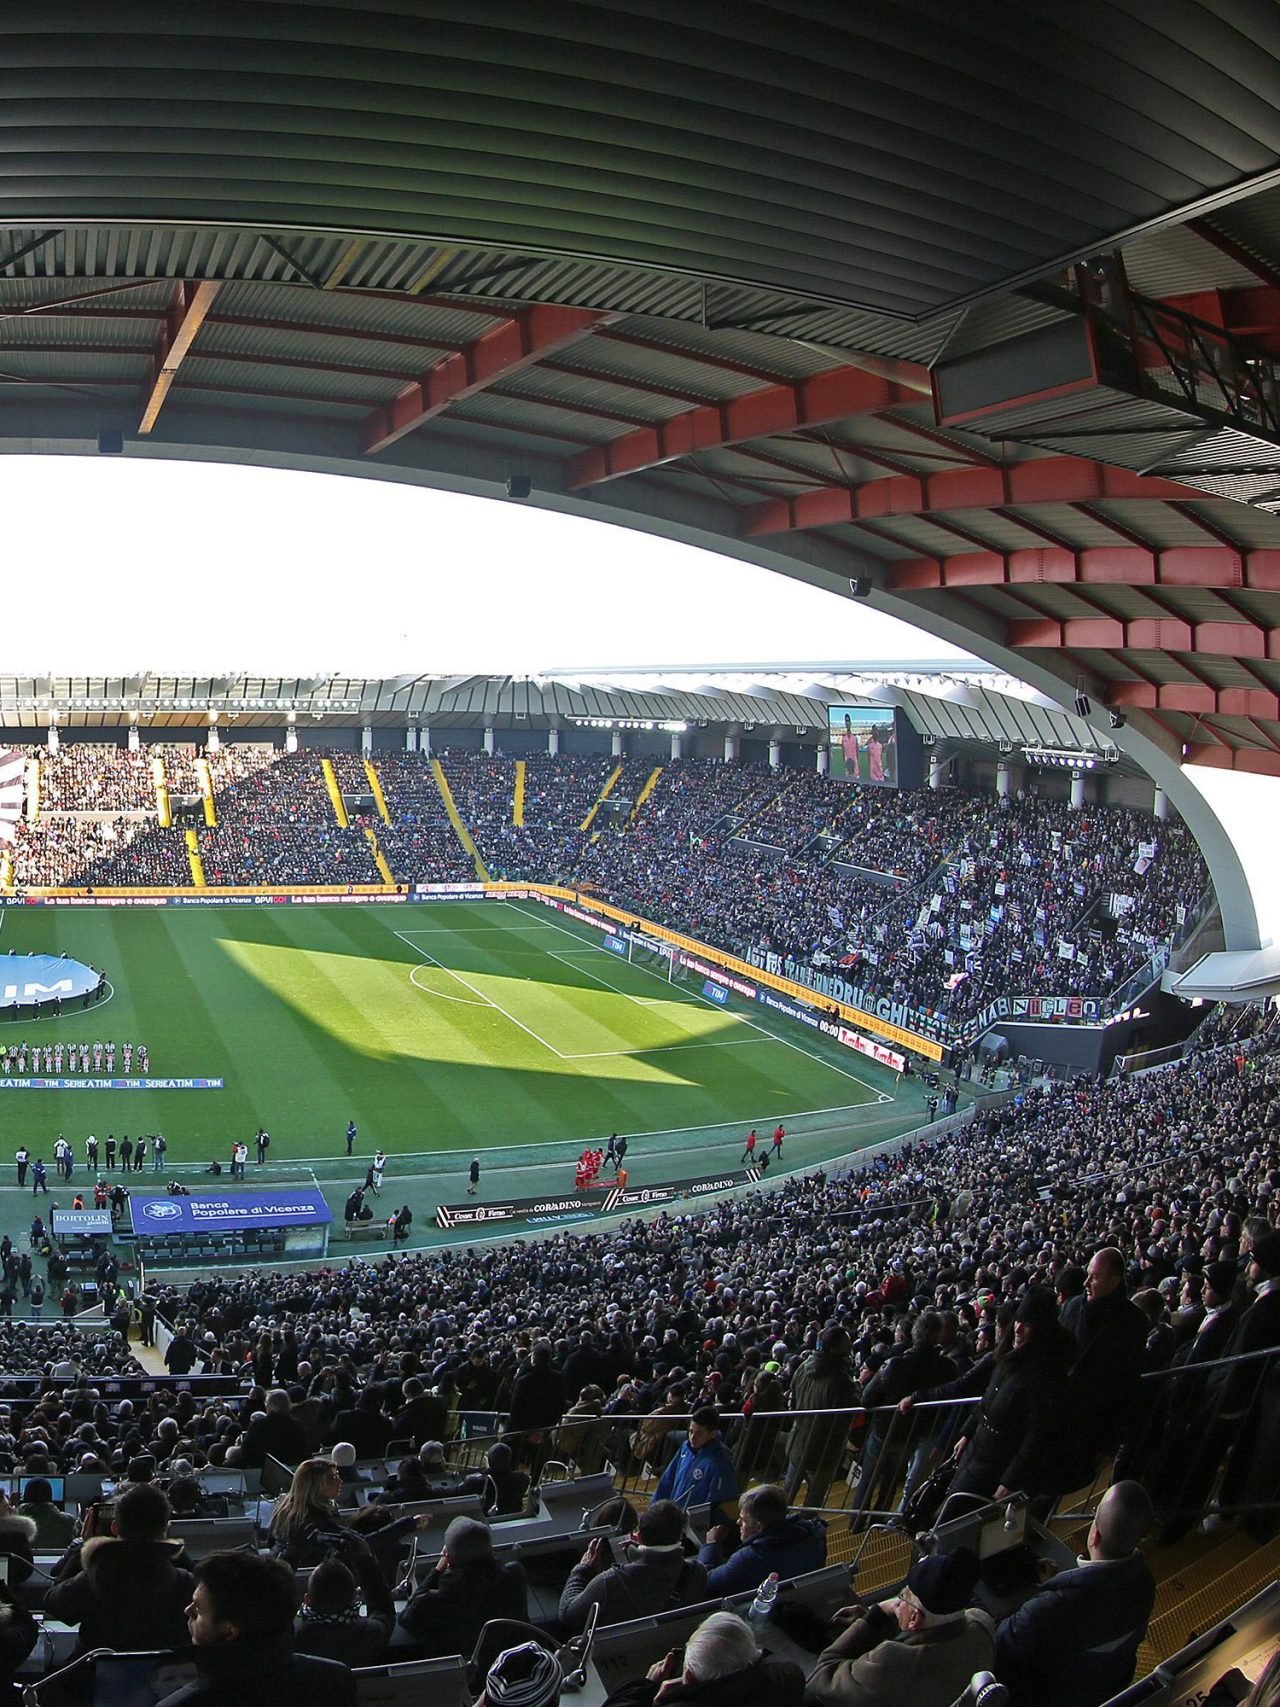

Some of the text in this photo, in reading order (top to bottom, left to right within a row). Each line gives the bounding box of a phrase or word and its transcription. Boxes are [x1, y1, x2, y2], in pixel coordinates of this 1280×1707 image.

[44, 897, 54, 905] La
[56, 897, 69, 905] tua
[70, 897, 95, 905] banca
[96, 898, 126, 906] sempre
[133, 898, 167, 906] ovunque
[200, 897, 223, 905] Popolare
[291, 895, 301, 903] La
[317, 895, 339, 904] banca
[340, 896, 369, 905] sempre
[376, 895, 407, 904] ovunque
[434, 893, 457, 901] Popolare
[464, 892, 484, 900] Vicenza
[611, 939, 623, 951] TIM
[679, 955, 686, 966] La
[686, 958, 695, 969] tua
[694, 960, 710, 976] banca
[710, 968, 729, 985] sempre
[733, 979, 757, 999] ovunque
[710, 987, 725, 999] TIM
[766, 995, 778, 1009] Banca
[777, 1001, 797, 1017] Popolare
[800, 1011, 818, 1028] Vicenza
[819, 1018, 839, 1038] 00:00
[13, 1079, 31, 1087] TIM
[94, 1080, 112, 1088] TIM
[175, 1079, 193, 1088] TIM
[190, 1201, 229, 1209] Banca
[192, 1204, 315, 1218] Popolare di Vicenza
